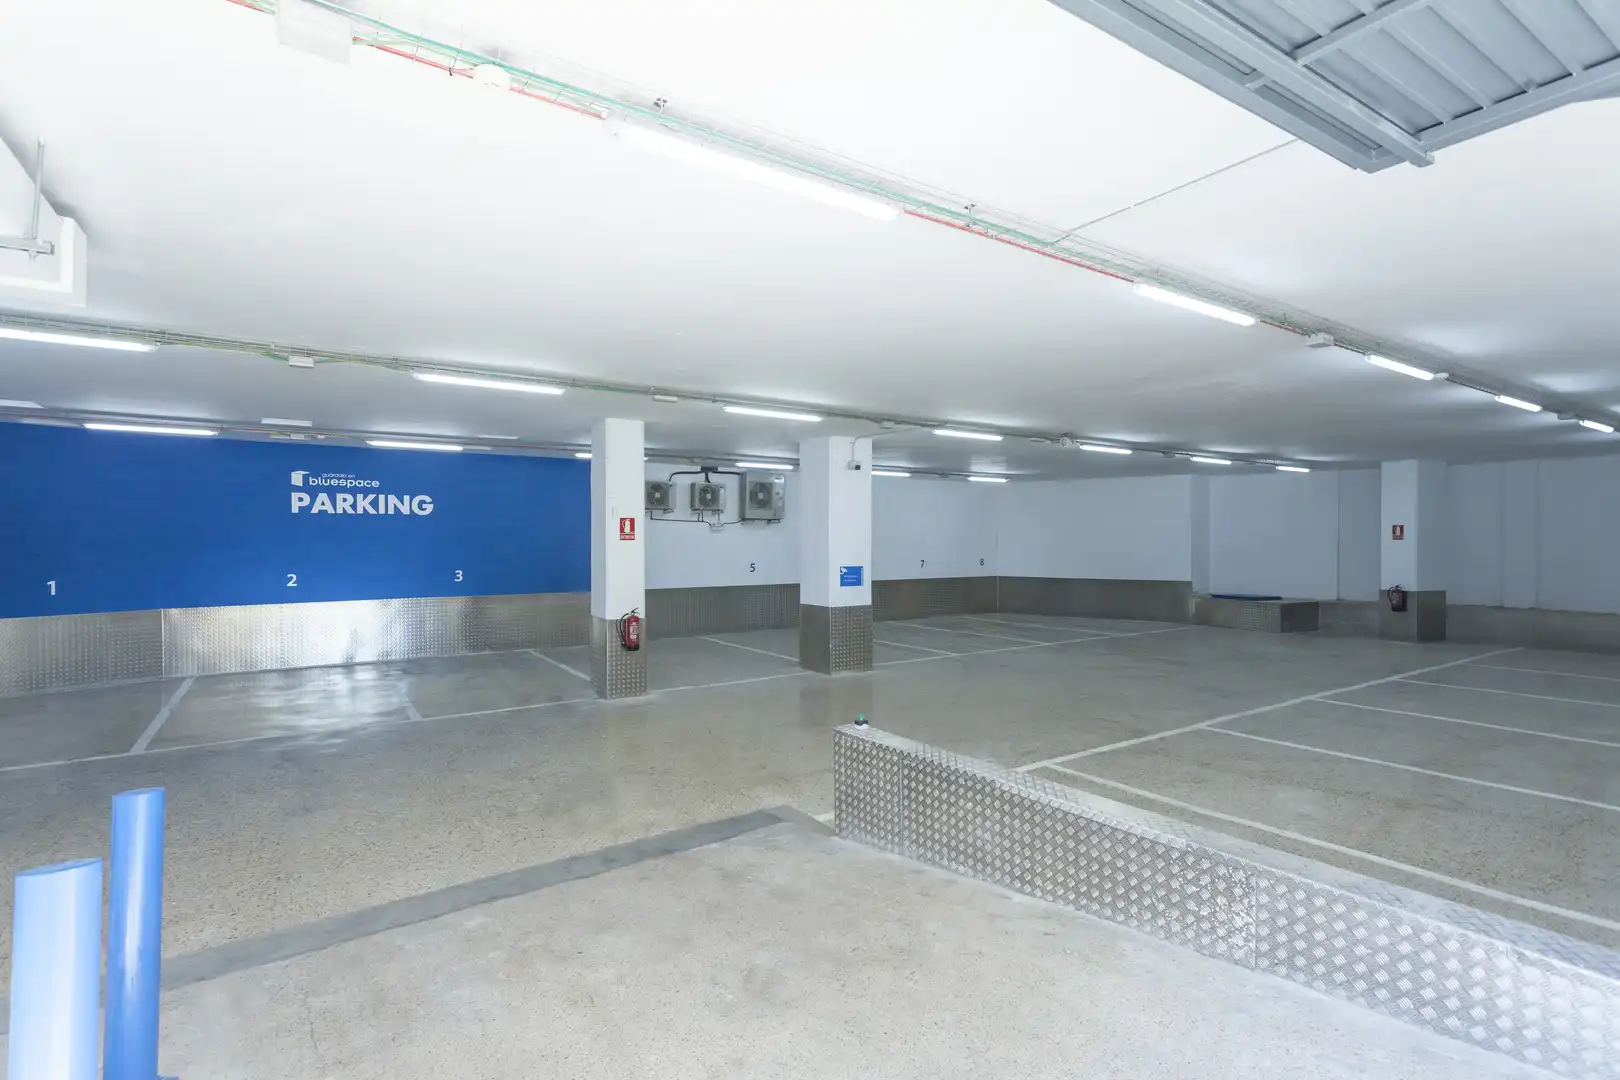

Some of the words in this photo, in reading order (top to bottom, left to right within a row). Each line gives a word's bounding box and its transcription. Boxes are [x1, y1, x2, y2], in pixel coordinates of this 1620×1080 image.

[309, 476, 380, 488] bluespace
[291, 492, 434, 516] PARKING
[749, 562, 756, 573] 5
[920, 559, 925, 568] 7
[979, 558, 985, 567] 8
[286, 573, 298, 587] 2
[454, 569, 463, 582] 3
[46, 580, 56, 596] 1
